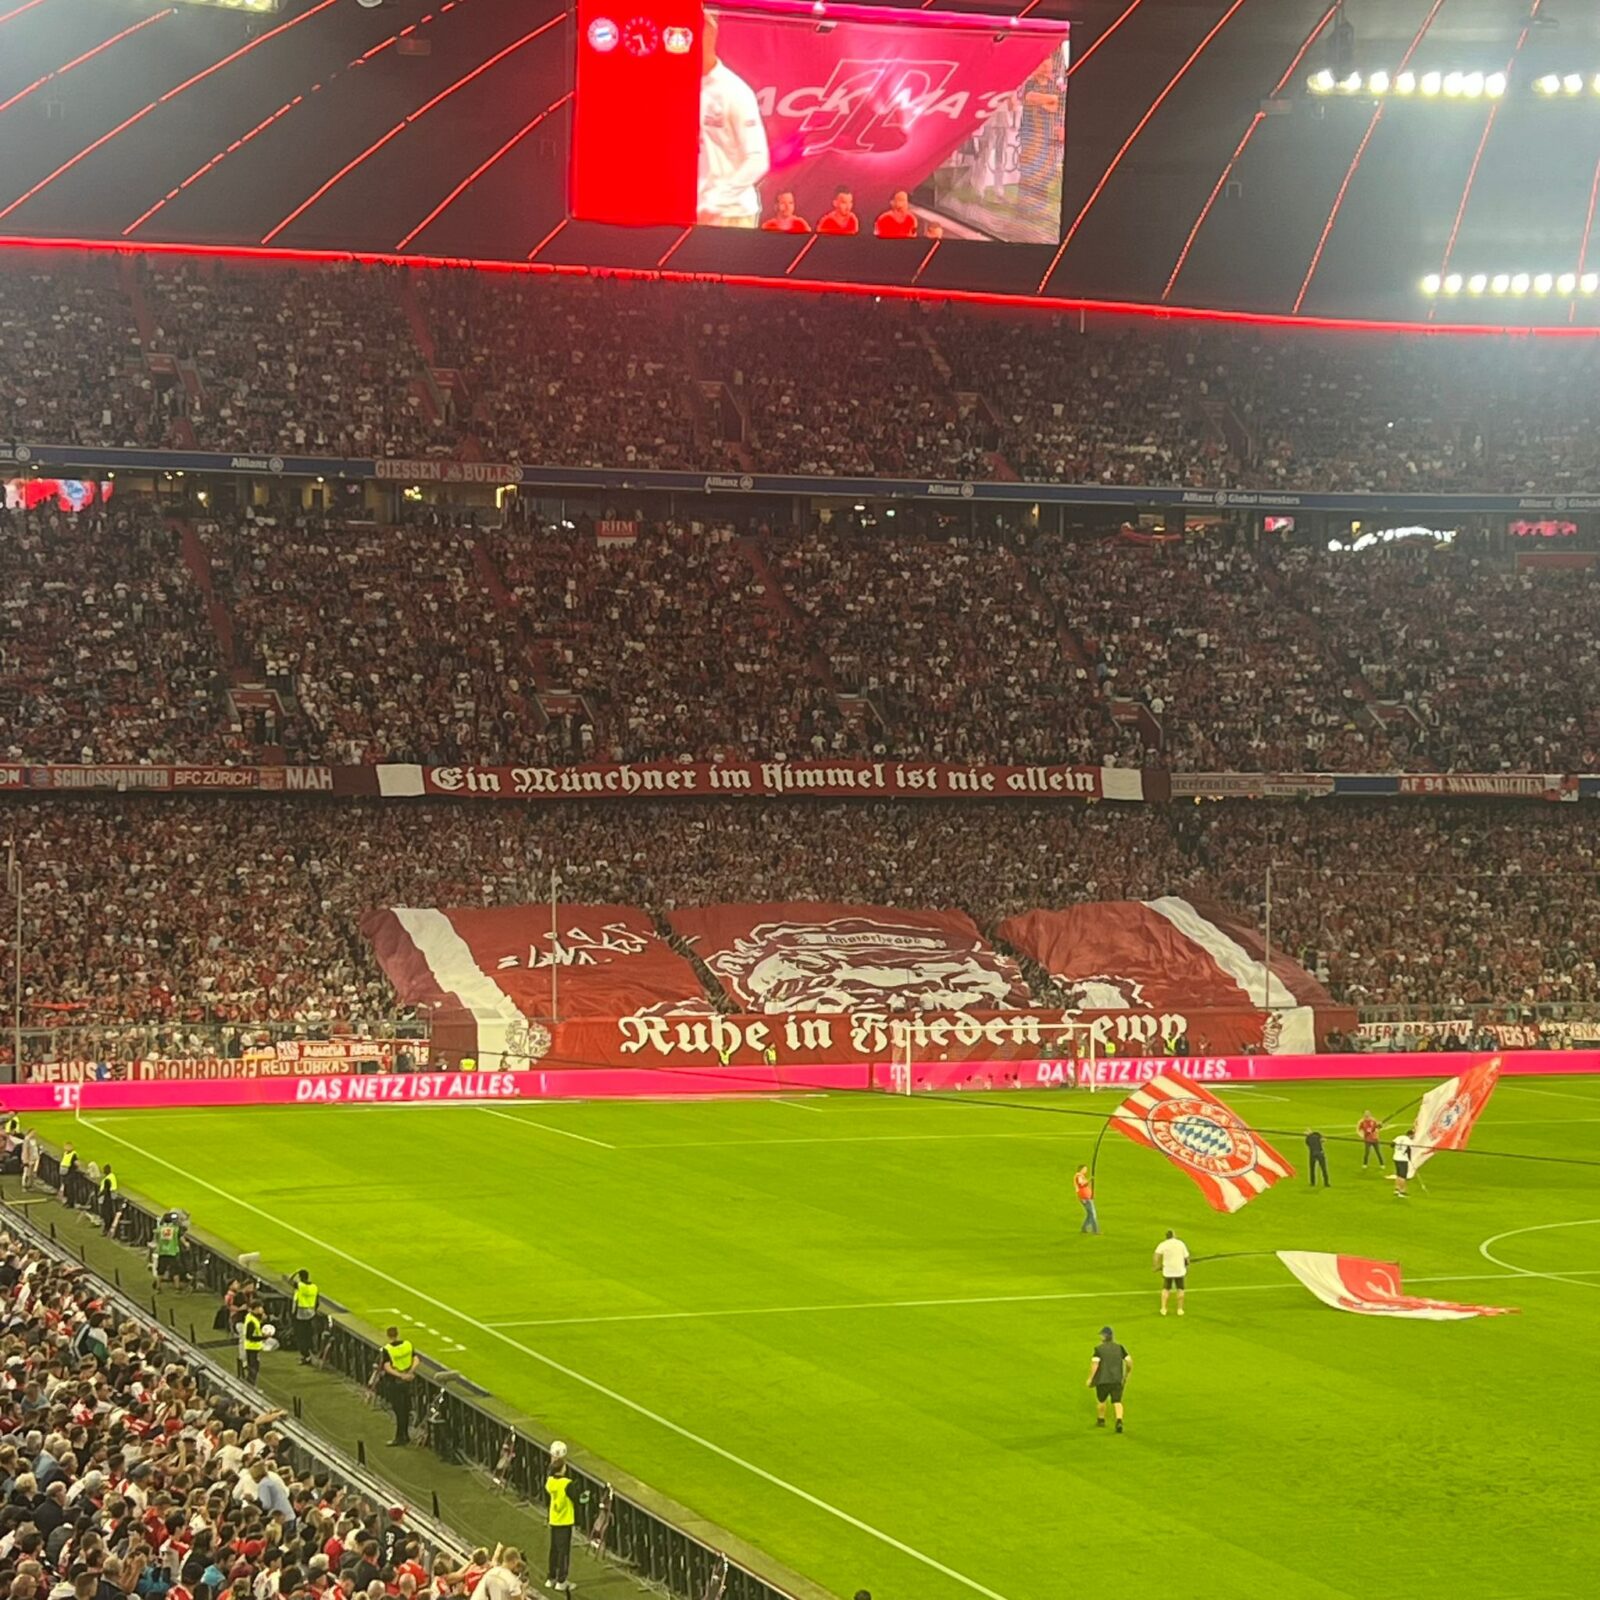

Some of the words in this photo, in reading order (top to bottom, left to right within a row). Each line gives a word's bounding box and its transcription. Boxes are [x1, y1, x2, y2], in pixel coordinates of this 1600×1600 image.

[375, 459, 441, 480] GIESSEN
[53, 768, 169, 788] SCHLOSSPANTHER
[173, 771, 201, 785] BFC
[203, 769, 252, 785] ZÜRICH
[286, 767, 333, 790] MAH
[430, 766, 501, 792] Ein
[510, 766, 697, 794] Münchner
[709, 764, 752, 788] im
[761, 763, 885, 792] Himmel
[895, 764, 938, 791] ist
[948, 766, 996, 792] nie
[1006, 766, 1096, 792] allein
[1447, 776, 1543, 795] WALDKIRCHEN
[619, 1015, 770, 1056] Ruhe
[784, 1014, 833, 1051] in
[850, 1012, 1041, 1053] Frieden
[1036, 1062, 1075, 1082] DAS
[1081, 1060, 1132, 1082] NETZ
[1135, 1060, 1167, 1080] IST
[296, 1079, 342, 1100] DAS
[348, 1077, 404, 1099] NETZ
[409, 1075, 446, 1096] IST
[448, 1074, 521, 1096] ALLES.
